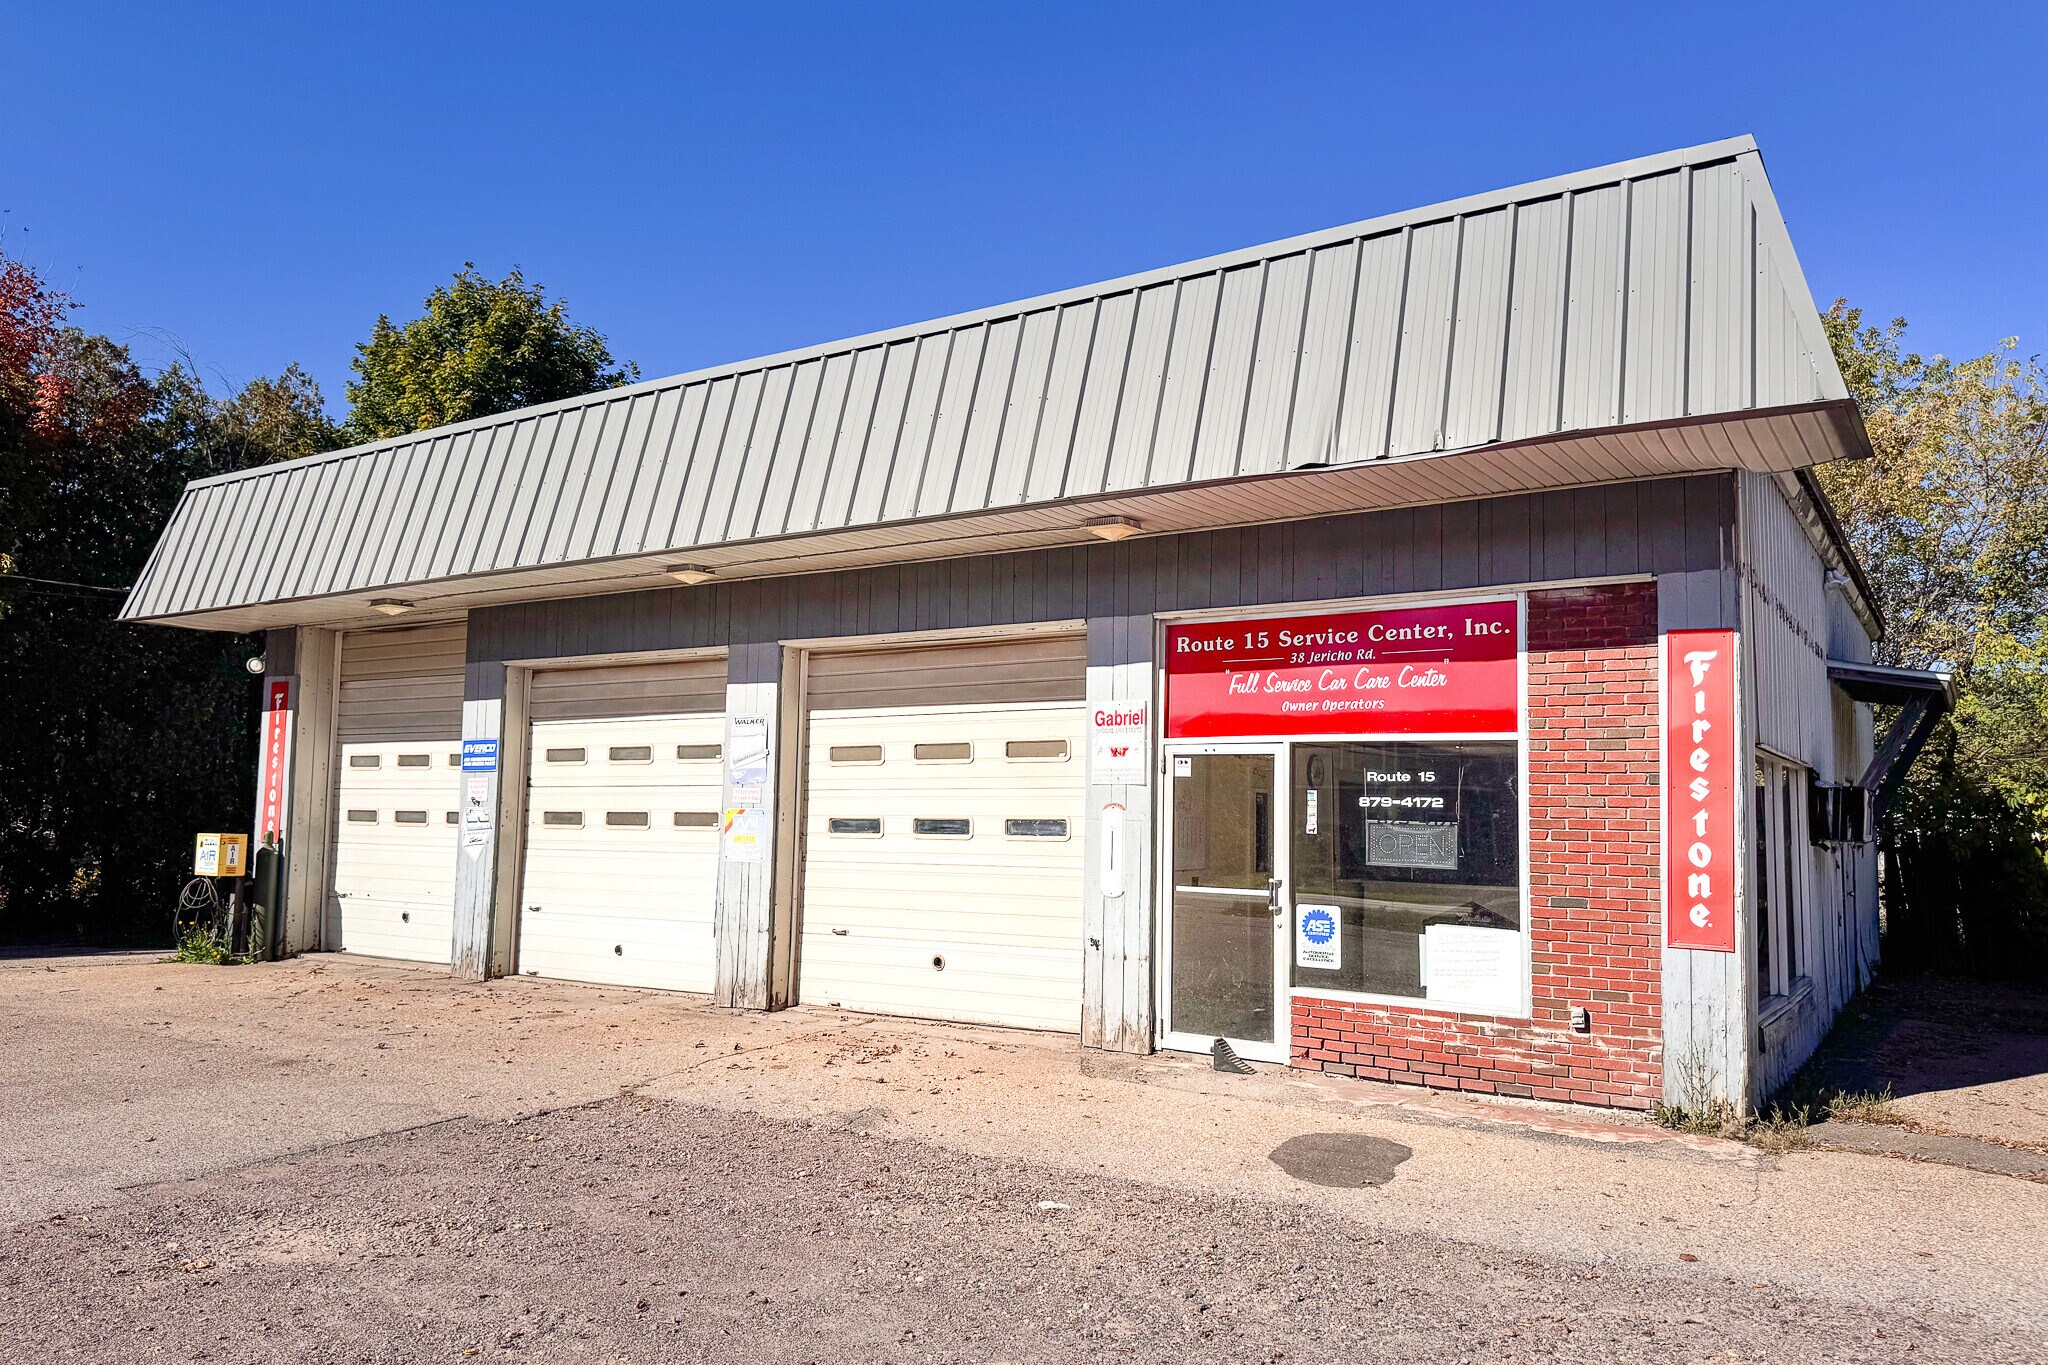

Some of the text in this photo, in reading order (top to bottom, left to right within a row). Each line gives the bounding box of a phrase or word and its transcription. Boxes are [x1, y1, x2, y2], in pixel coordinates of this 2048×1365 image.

[1176, 618, 1511, 653] Route 15 Service Center, Inc.
[1289, 649, 1376, 665] 38 Jericho Rd.
[1262, 671, 1312, 695] Service
[1317, 668, 1348, 692] Car
[1353, 665, 1391, 690] Care
[1281, 698, 1385, 713] Owner Operators
[734, 717, 765, 726] WALKER
[1095, 708, 1143, 727] Gabriel
[463, 743, 497, 755] EVERCO
[267, 693, 284, 832] Firestone
[1366, 771, 1436, 783] Route 15
[1358, 796, 1444, 808] 879-4172
[1378, 833, 1446, 857] OPEN
[199, 849, 217, 862] AIR
[1306, 920, 1331, 932] ASE
